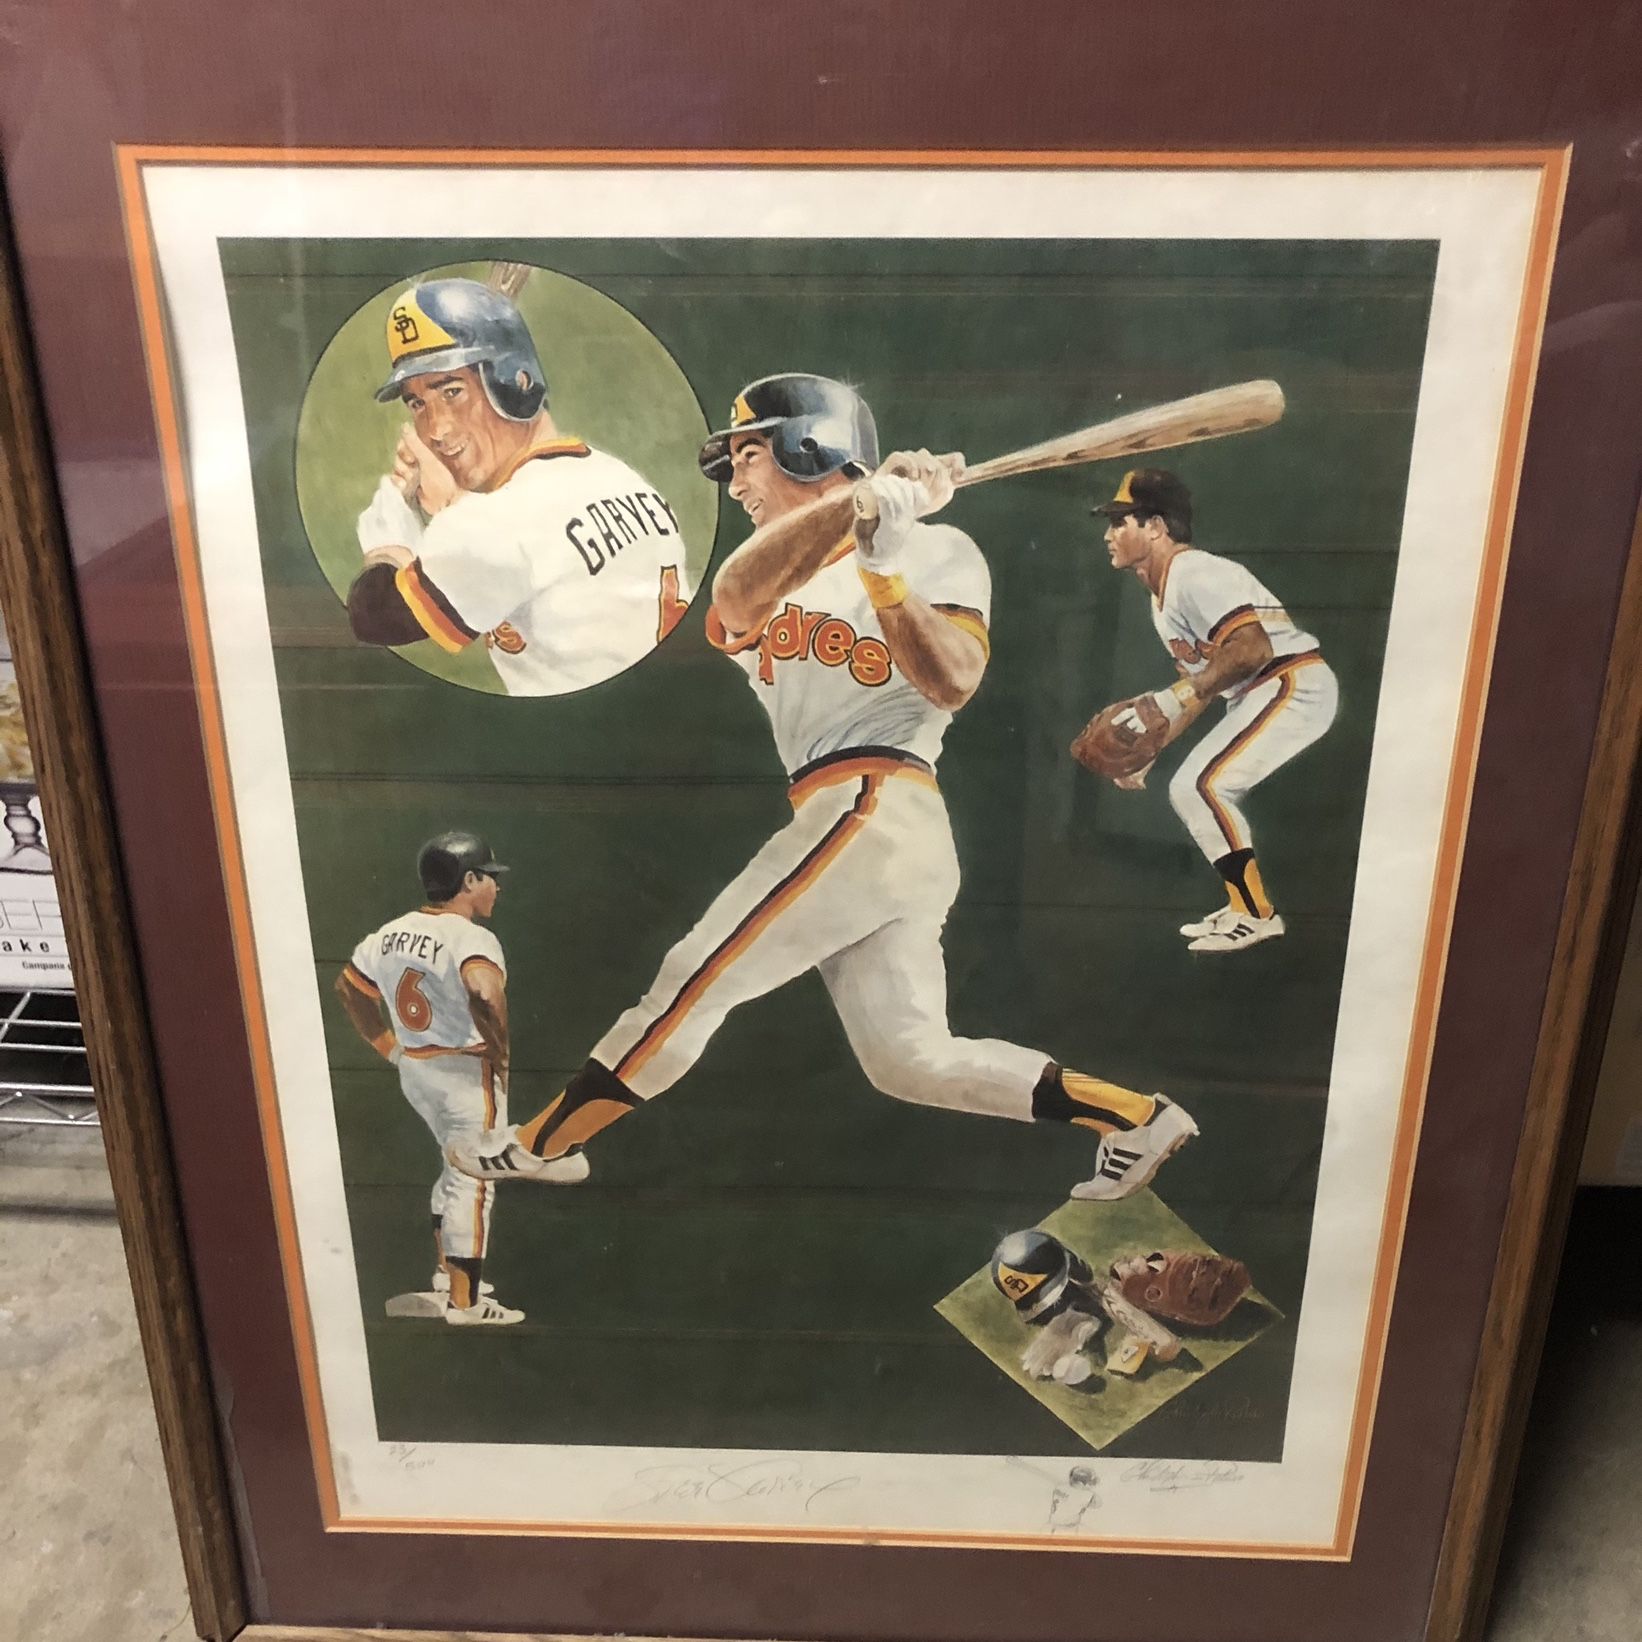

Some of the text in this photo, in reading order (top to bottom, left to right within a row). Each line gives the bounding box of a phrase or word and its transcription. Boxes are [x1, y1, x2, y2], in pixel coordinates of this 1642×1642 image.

[566, 493, 679, 576] GARVEY
[381, 932, 444, 965] GARVEY
[395, 966, 433, 1033] 6
